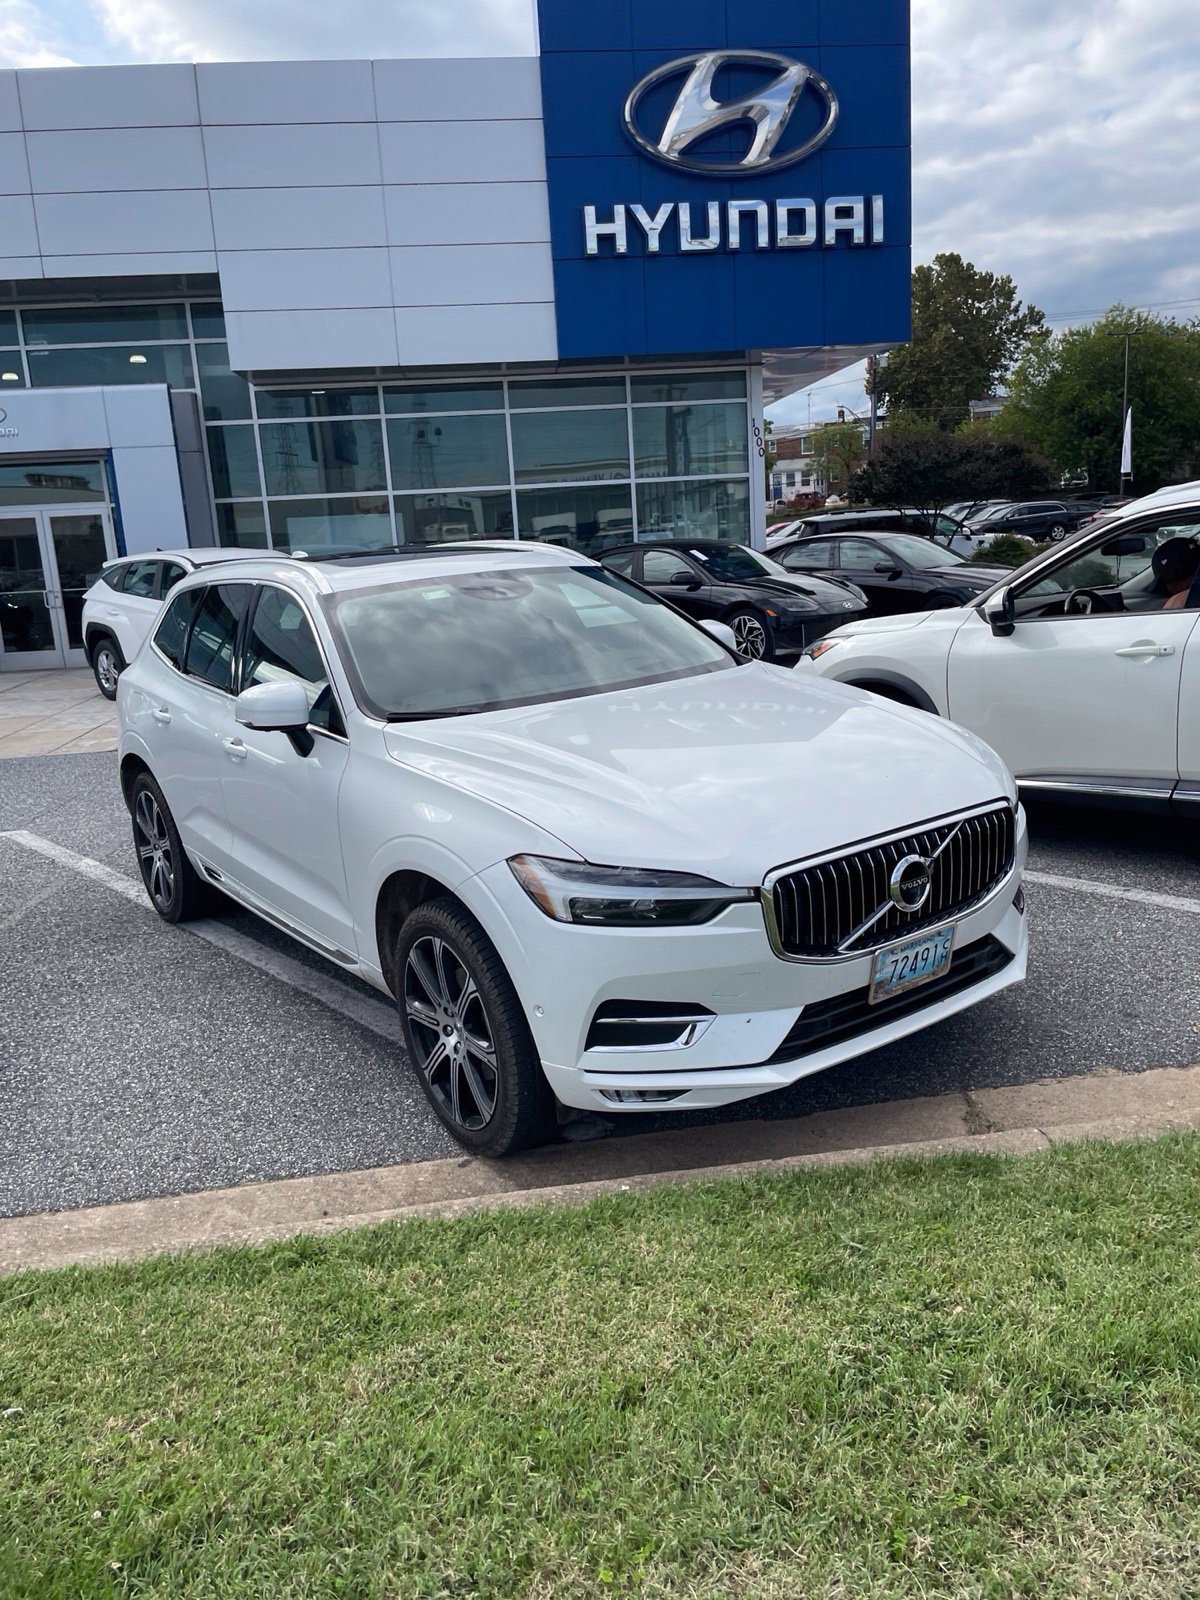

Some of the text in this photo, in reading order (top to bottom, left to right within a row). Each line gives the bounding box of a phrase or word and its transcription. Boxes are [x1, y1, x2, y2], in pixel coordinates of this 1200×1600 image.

[583, 194, 885, 256] HYUNDAI
[752, 417, 765, 457] 1000
[901, 877, 928, 890] VOLVO
